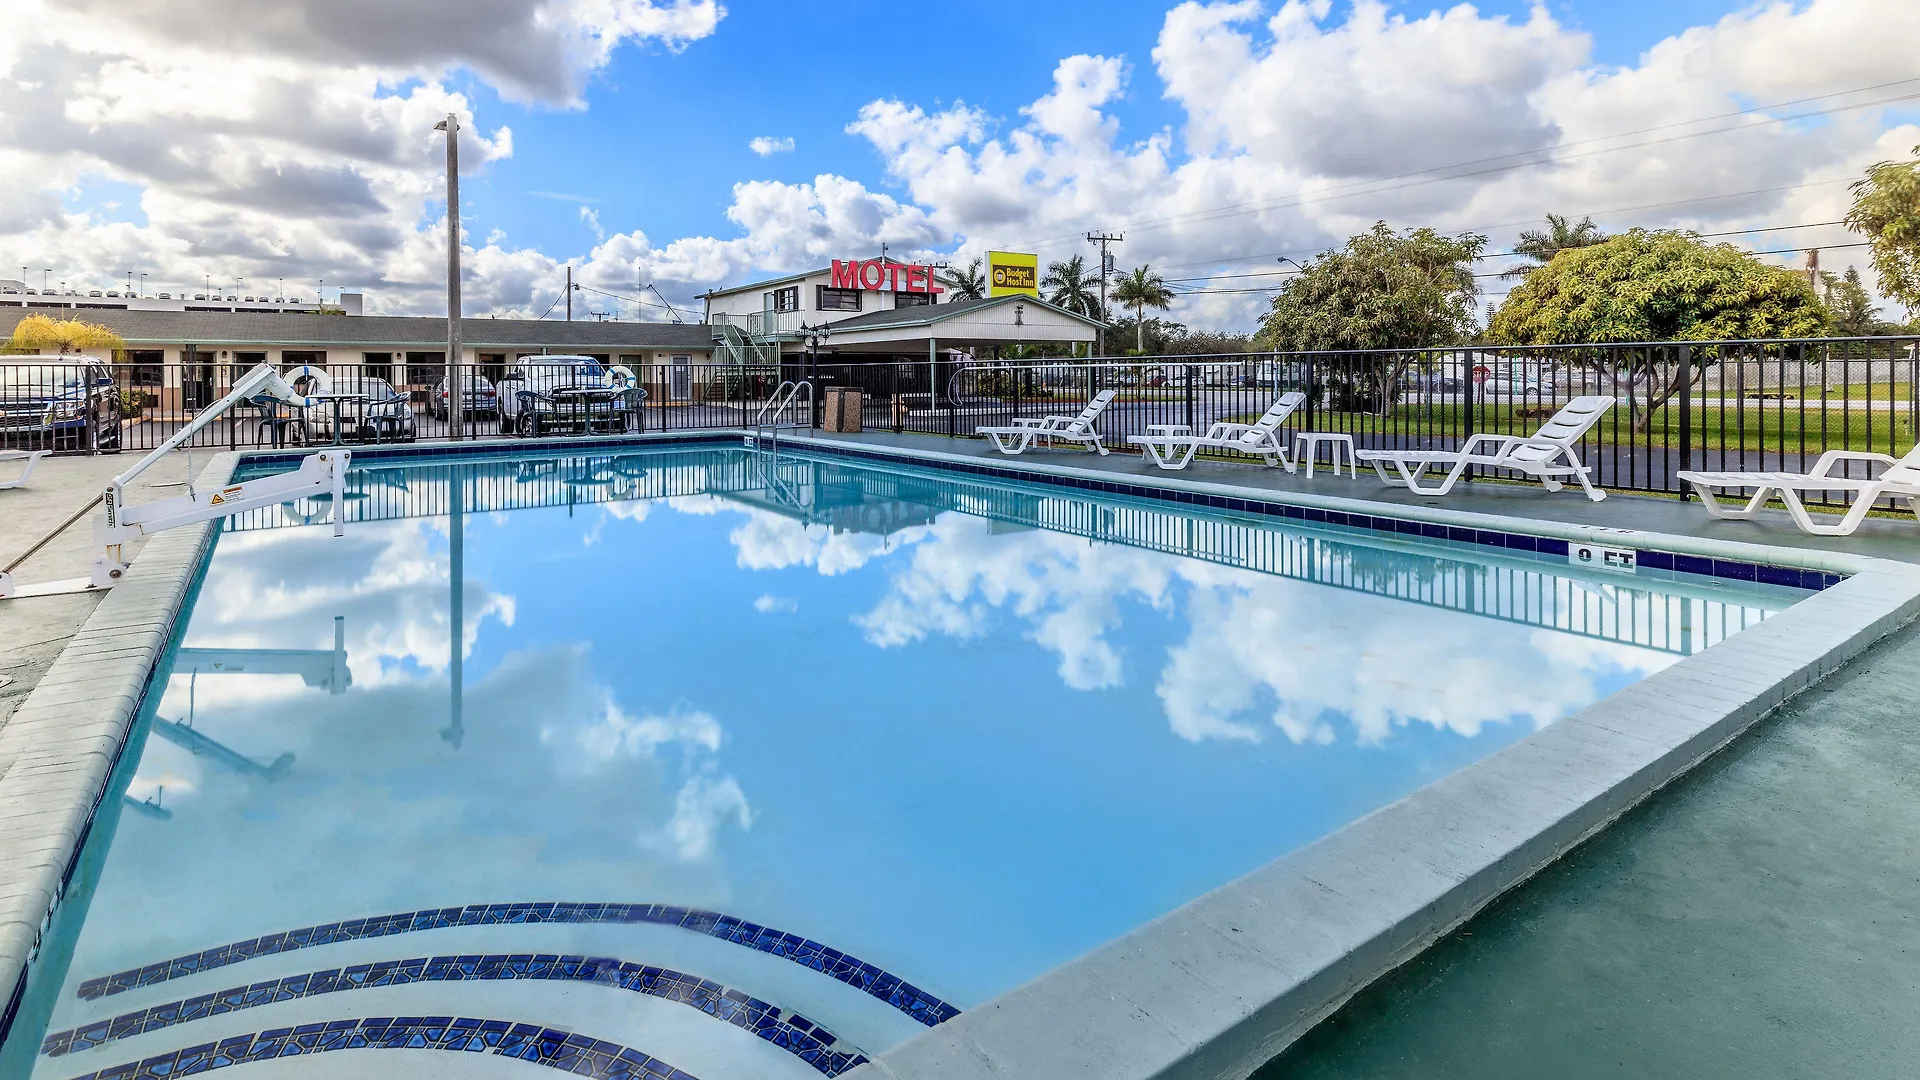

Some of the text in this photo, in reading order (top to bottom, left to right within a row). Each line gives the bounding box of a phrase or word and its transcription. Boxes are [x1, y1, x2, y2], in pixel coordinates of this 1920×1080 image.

[831, 259, 944, 294] MOTEL
[1006, 268, 1030, 279] Budget
[1006, 277, 1034, 287] Host Inn
